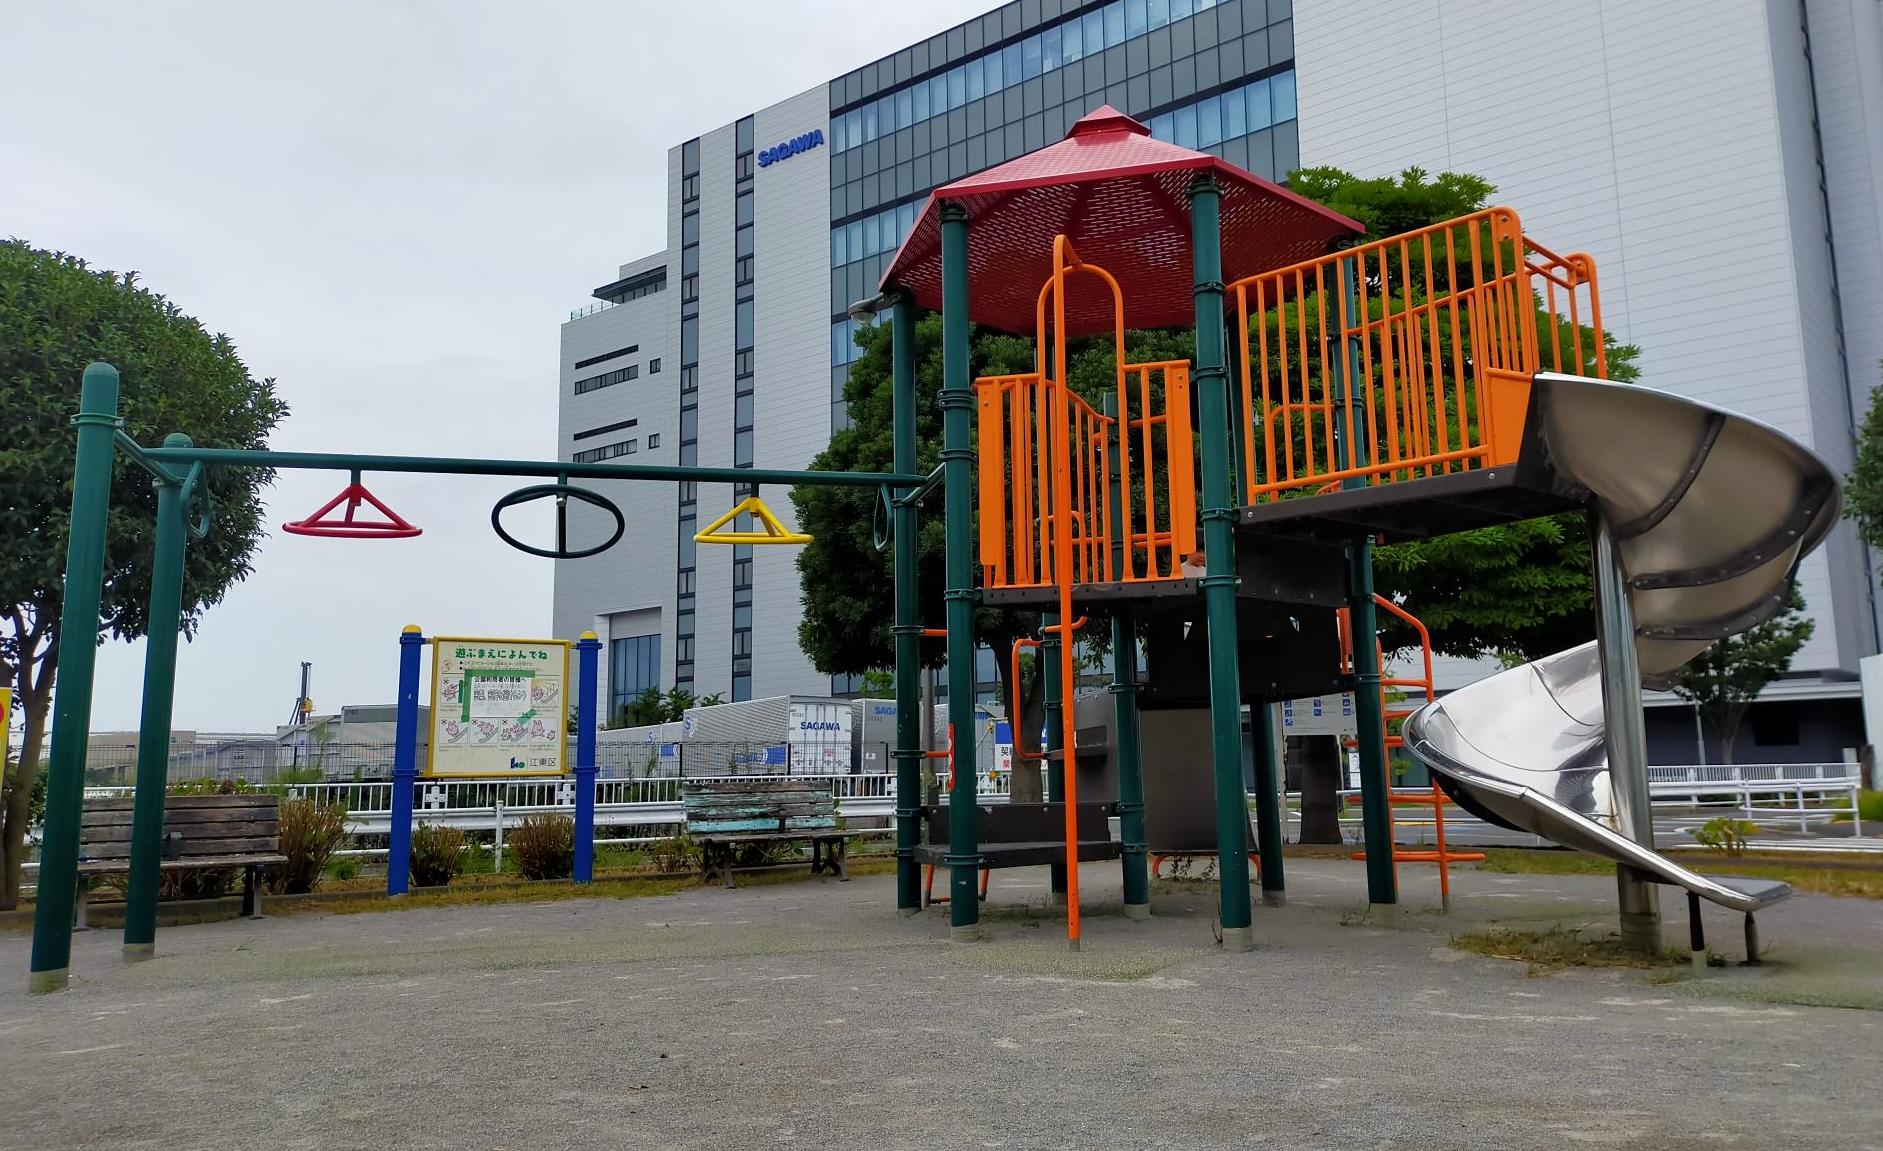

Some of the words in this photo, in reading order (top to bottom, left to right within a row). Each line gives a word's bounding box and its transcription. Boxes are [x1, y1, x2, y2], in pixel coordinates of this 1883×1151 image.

[758, 129, 825, 168] SAGAWA
[455, 646, 548, 660] 遊ぶまえによんでね
[800, 721, 841, 731] SAGAWA
[529, 757, 557, 767] 江東区
